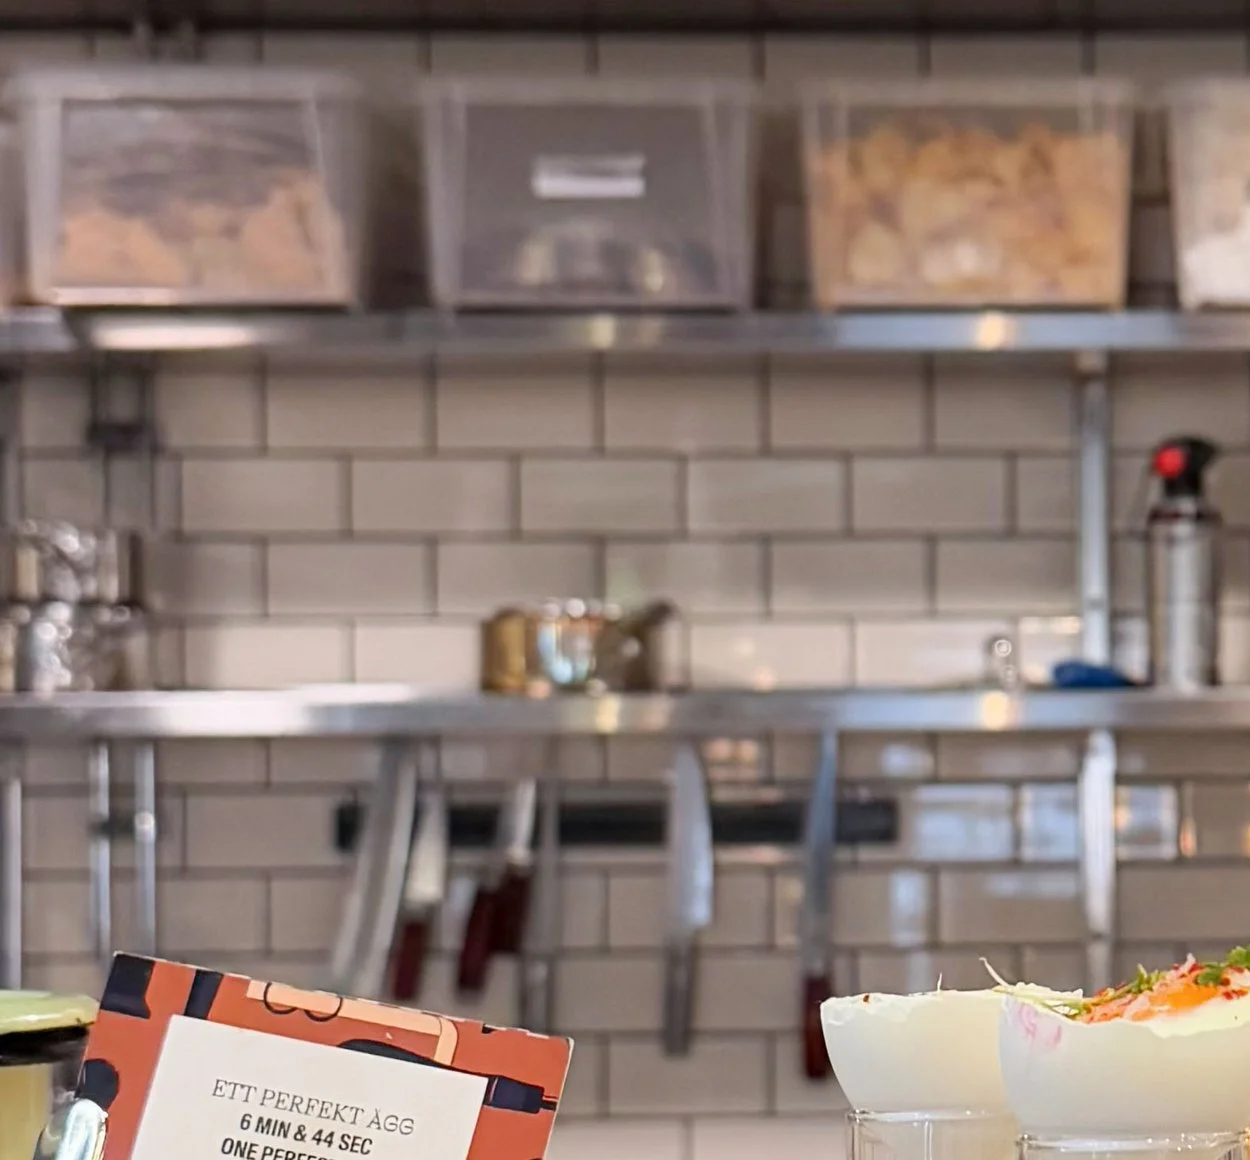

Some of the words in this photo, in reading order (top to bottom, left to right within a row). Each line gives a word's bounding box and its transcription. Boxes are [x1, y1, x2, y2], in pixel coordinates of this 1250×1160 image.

[212, 1078, 257, 1103] ETT
[259, 1088, 364, 1125] PERFEKT
[221, 1137, 259, 1160] ONE
[240, 1113, 251, 1131] 6
[254, 1116, 292, 1139] MIN
[293, 1124, 307, 1142] &
[312, 1129, 335, 1148] 44
[338, 1133, 373, 1156] SEC
